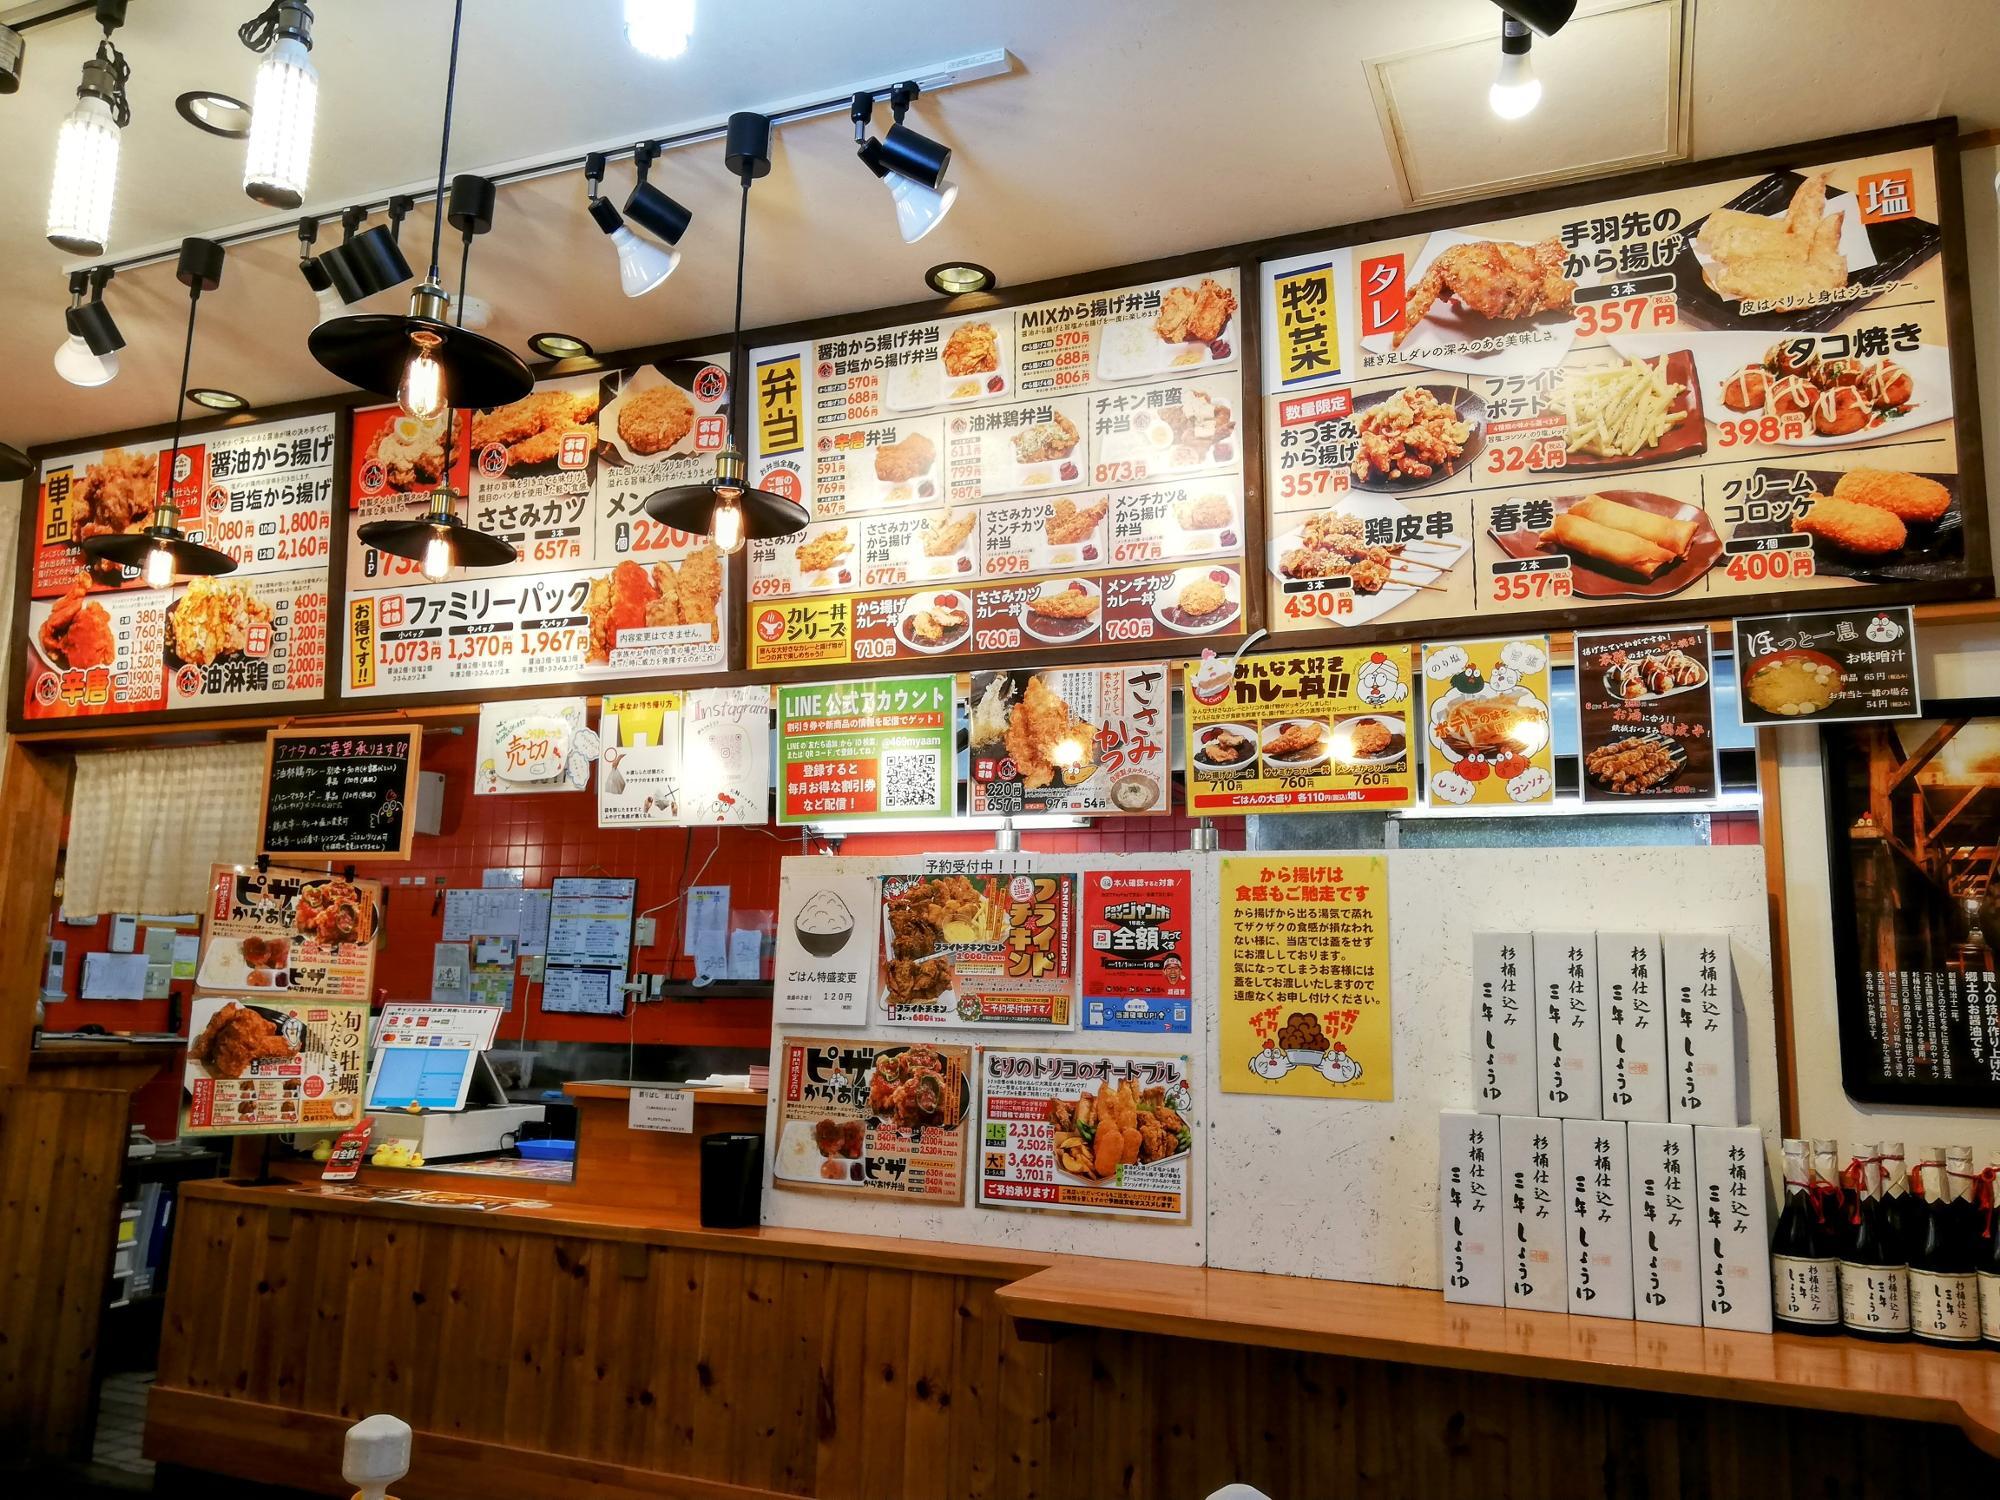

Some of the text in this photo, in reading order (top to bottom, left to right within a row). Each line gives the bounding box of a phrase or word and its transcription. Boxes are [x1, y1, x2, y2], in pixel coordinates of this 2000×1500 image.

[1866, 179, 1910, 216] 塩
[1562, 208, 1681, 248] 手羽先の
[1564, 236, 1681, 278] から揚げ
[1369, 265, 1399, 329] タレ
[1611, 283, 1636, 296] 3本
[1742, 282, 1918, 313] 皮はパリッと身はジューシー。
[1021, 290, 1161, 328] MIXから揚げ弁当
[1575, 298, 1675, 336] 357円
[1283, 278, 1331, 372] 惣菜
[818, 326, 939, 361] 醤油から揚げ弁当
[1363, 330, 1557, 367] 継ぎ足しダレの深みのある美味しさ。
[1788, 324, 1921, 366] タコ焼き
[834, 347, 938, 375] 旨塩から揚げ弁当
[848, 376, 878, 390] 570円
[1486, 369, 1565, 395] フライド
[762, 368, 798, 448] 弁当
[848, 392, 878, 405] 688円
[1096, 388, 1182, 414] チキン南蛮
[1286, 396, 1345, 420] 数量限定
[1487, 395, 1549, 419] ポテト
[848, 408, 878, 420] 806円
[969, 404, 1053, 432] 油淋鶏弁当
[1096, 414, 1130, 435] 弁当
[834, 427, 896, 451] 辛唐弁当
[1281, 422, 1360, 447] おつまみ
[1719, 417, 1802, 446] 398円
[212, 434, 334, 477] 醤油から揚げ
[1488, 444, 1566, 474] 324円
[817, 463, 845, 474] 591円
[1096, 461, 1146, 483] 873円
[231, 478, 332, 512] 旨塩から揚げ
[817, 482, 845, 494] 769円
[951, 486, 981, 498] 987円
[1281, 471, 1348, 497] 357円
[1723, 474, 1814, 500] クリーム
[47, 474, 70, 539] 単品
[817, 502, 845, 514] 947円
[1116, 490, 1187, 507] メンチカツ&
[478, 498, 586, 531] ささみカツ
[1116, 506, 1168, 522] から揚げ
[1491, 500, 1553, 532] 春巻
[1724, 498, 1815, 523] コロッケ
[207, 520, 254, 543] 1,080円
[279, 511, 329, 536] 1,800円
[551, 529, 564, 538] 3本
[867, 519, 929, 535] ささみカツ&
[987, 519, 1044, 536] メンチカツ
[1365, 511, 1453, 545] 鶏皮串
[278, 536, 328, 560] 2,160円
[534, 539, 580, 561] 657円
[867, 533, 911, 548] から揚げ
[867, 550, 890, 562] 弁当
[1521, 561, 1540, 571] 2本
[1727, 552, 1813, 581] 400円
[752, 579, 791, 595] 699円
[866, 568, 906, 585] 677円
[1107, 575, 1175, 593] メンチカツ
[294, 593, 327, 608] 400円
[406, 582, 590, 624] ファミリーパック
[976, 586, 1041, 604] ささみカツ
[1284, 593, 1353, 617] 430円
[136, 610, 164, 622] 380円
[294, 610, 326, 624] 800円
[787, 605, 846, 624] カレー丼
[857, 598, 906, 615] から揚げ
[135, 626, 163, 638] 760円
[289, 626, 325, 640] 1,200円
[467, 624, 495, 633] 中パック
[540, 619, 568, 627] 大パック
[787, 622, 846, 640] シリーズ
[354, 604, 371, 682] お得です!!
[521, 630, 588, 655] 1,967円
[620, 628, 702, 643] 内容変更はできません。
[978, 630, 1019, 648] 760円
[1747, 621, 1858, 657] ほっと一息
[131, 641, 163, 654] 1,140円
[288, 642, 324, 658] 1,600円
[380, 641, 441, 666] 1,073円
[449, 636, 512, 661] 1,370円
[856, 640, 895, 658] 710円
[1847, 650, 1906, 663] お味噌汁
[130, 656, 162, 670] 1,520円
[287, 658, 324, 674] 2,000円
[1235, 656, 1344, 678] みんな大好き
[61, 668, 109, 704] 辛唐
[129, 671, 161, 685] 1,900円
[200, 661, 268, 695] 油淋鶏
[287, 674, 323, 691] 2,400円
[1864, 673, 1885, 681] 65円
[128, 687, 160, 701] 2,280円
[1235, 674, 1350, 703] カレー丼!!
[1829, 687, 1909, 699] お弁当と一緒の場合
[612, 701, 672, 711] 上手なお持ち帰り方
[693, 700, 768, 723] Instagram
[786, 687, 943, 717] LINE 公式アカウント
[1129, 671, 1161, 764] ささみ
[506, 737, 548, 772] 売切
[1095, 720, 1128, 772] かつ
[803, 763, 858, 777] 登録すると
[1199, 770, 1254, 780] から揚げカレー丼
[1264, 767, 1329, 777] ササミかつカレー丼
[788, 780, 876, 795] 毎月お得な割引券
[1210, 781, 1242, 791] 710円
[1513, 775, 1545, 796] コンソメ
[803, 798, 855, 811] など配信!
[1084, 798, 1105, 808] 54円
[1233, 795, 1292, 804] ごはんの大盛り
[1260, 867, 1343, 883] から揚げは
[1236, 885, 1369, 902] 食感もご馳走です
[1234, 909, 1372, 918] から揚げから出る湯気で蒸れ
[1034, 879, 1055, 976] フライド
[1114, 927, 1159, 950] 全額
[1234, 922, 1373, 933] てザクザクの食感が損なわれ
[1010, 904, 1027, 976] チキン
[1234, 950, 1347, 960] にお渡ししております。
[789, 971, 856, 984] ごはん特盛変更
[1500, 945, 1519, 1027] 杉桶仕込み
[1630, 946, 1651, 1030] 杉桶仕込み
[1965, 971, 1984, 1064] 郷土のお醤油です。
[1982, 971, 2000, 1081] 職人の技が作り上げた
[1482, 983, 1502, 1100] 三年しょうゆ
[1612, 984, 1632, 1105] 三年しょうゆ
[807, 1047, 873, 1085] ピザ
[988, 1056, 1180, 1083] とりのトリコのオードブル
[804, 1085, 870, 1107] からあげ
[1009, 1124, 1053, 1138] 2,316円
[1008, 1153, 1053, 1168] 3,426円
[1016, 1169, 1052, 1181] 3,701円
[989, 1184, 1054, 1198] ご予約承ります!
[1728, 1145, 1750, 1234] 杉桶仕込み
